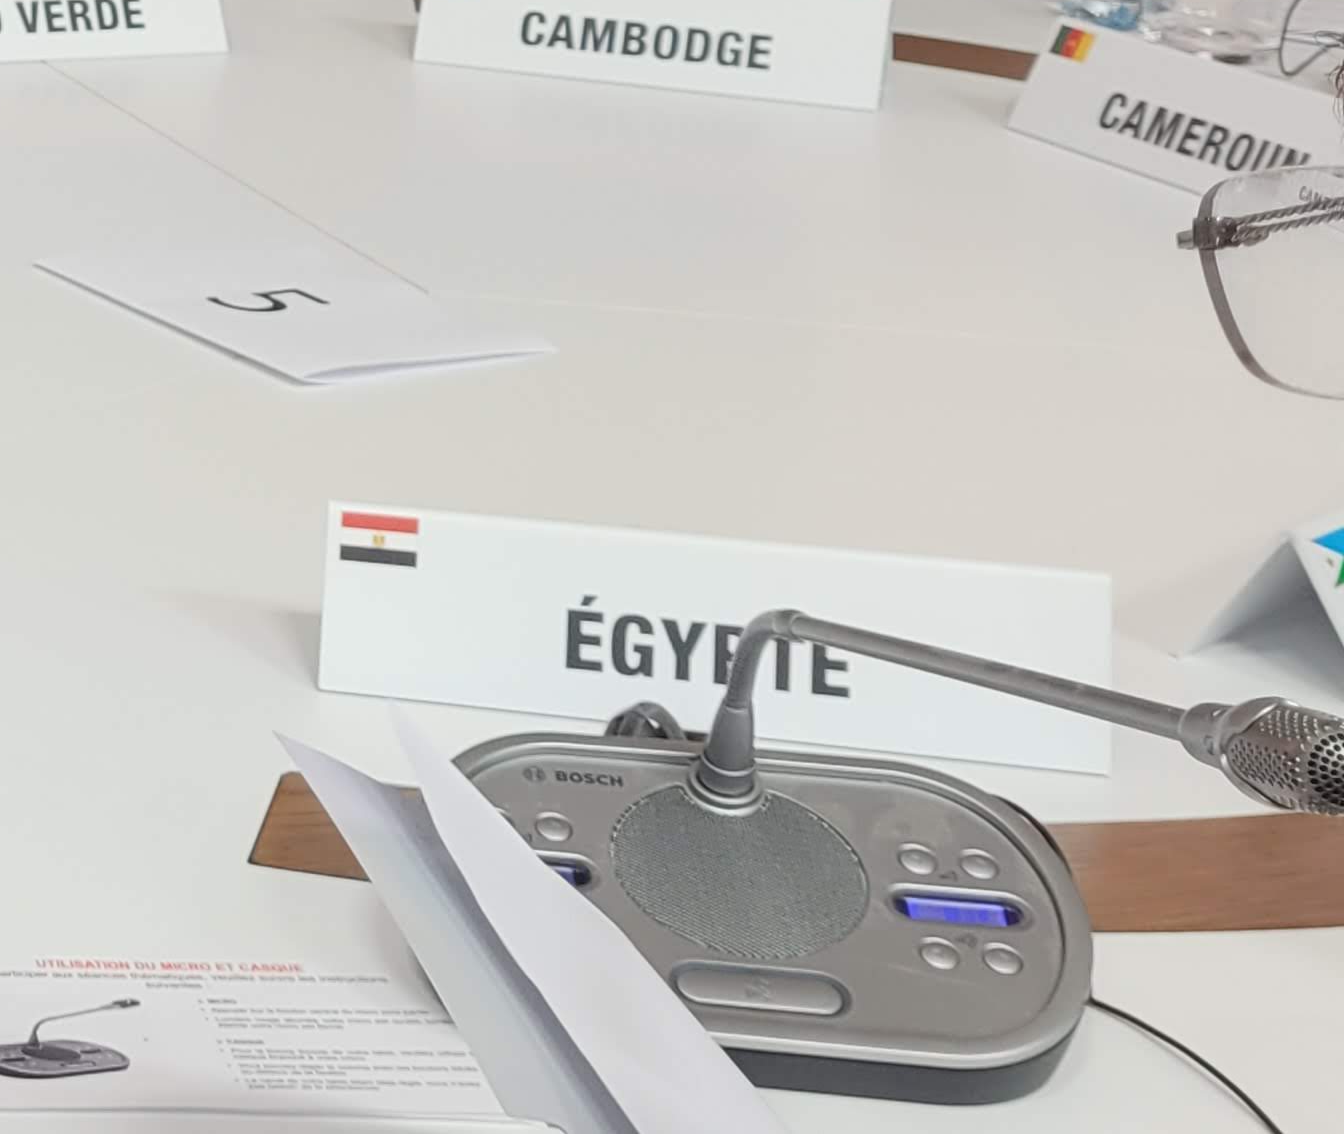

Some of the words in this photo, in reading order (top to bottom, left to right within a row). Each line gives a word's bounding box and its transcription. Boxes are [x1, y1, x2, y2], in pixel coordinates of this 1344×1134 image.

[520, 10, 774, 70] CAMBODGE
[206, 287, 330, 313] 5
[554, 770, 624, 787] BOSCH
[35, 958, 130, 971] UTILISATION
[134, 960, 156, 971] DU
[159, 961, 212, 972] MICRO
[216, 962, 234, 972] ET
[239, 962, 304, 974] CASQUE
